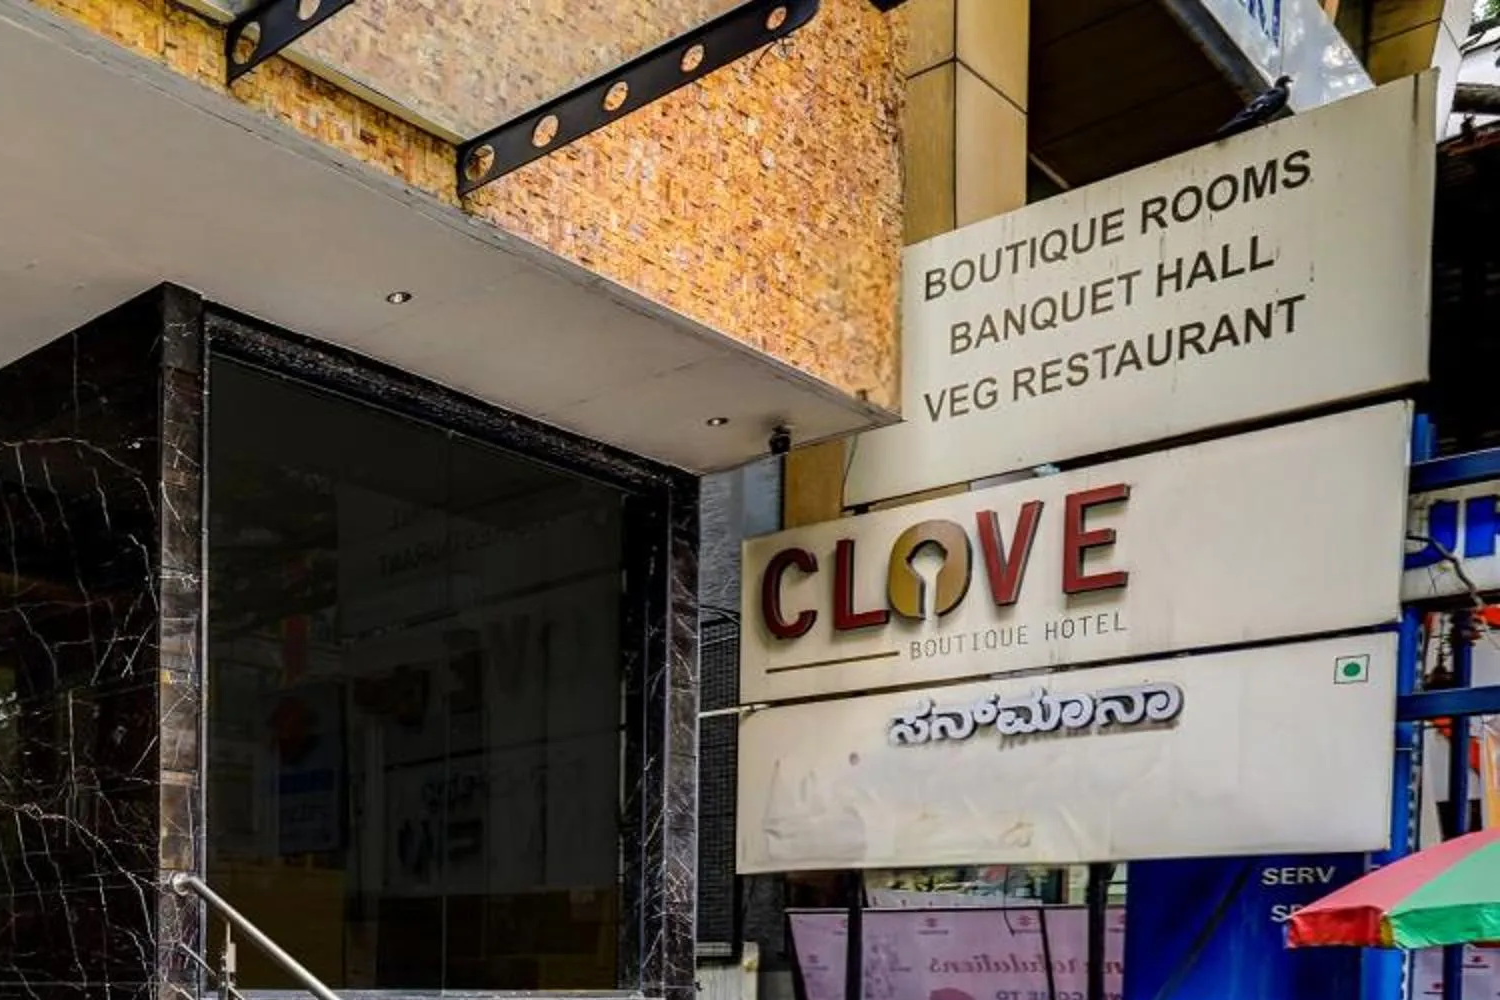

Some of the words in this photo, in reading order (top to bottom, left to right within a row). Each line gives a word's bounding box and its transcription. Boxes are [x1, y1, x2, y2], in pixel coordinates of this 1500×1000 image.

[924, 208, 1125, 302] BOUTIQUE
[1140, 149, 1311, 236] ROOMS
[924, 376, 998, 423] VEG
[1011, 295, 1306, 403] RESTAURANT
[949, 271, 1141, 356] BANQUET
[1155, 235, 1275, 298] HALL
[761, 483, 1132, 640] CLOVE
[909, 625, 1029, 660] BOUTIQUE
[1045, 612, 1128, 642] HOTEL
